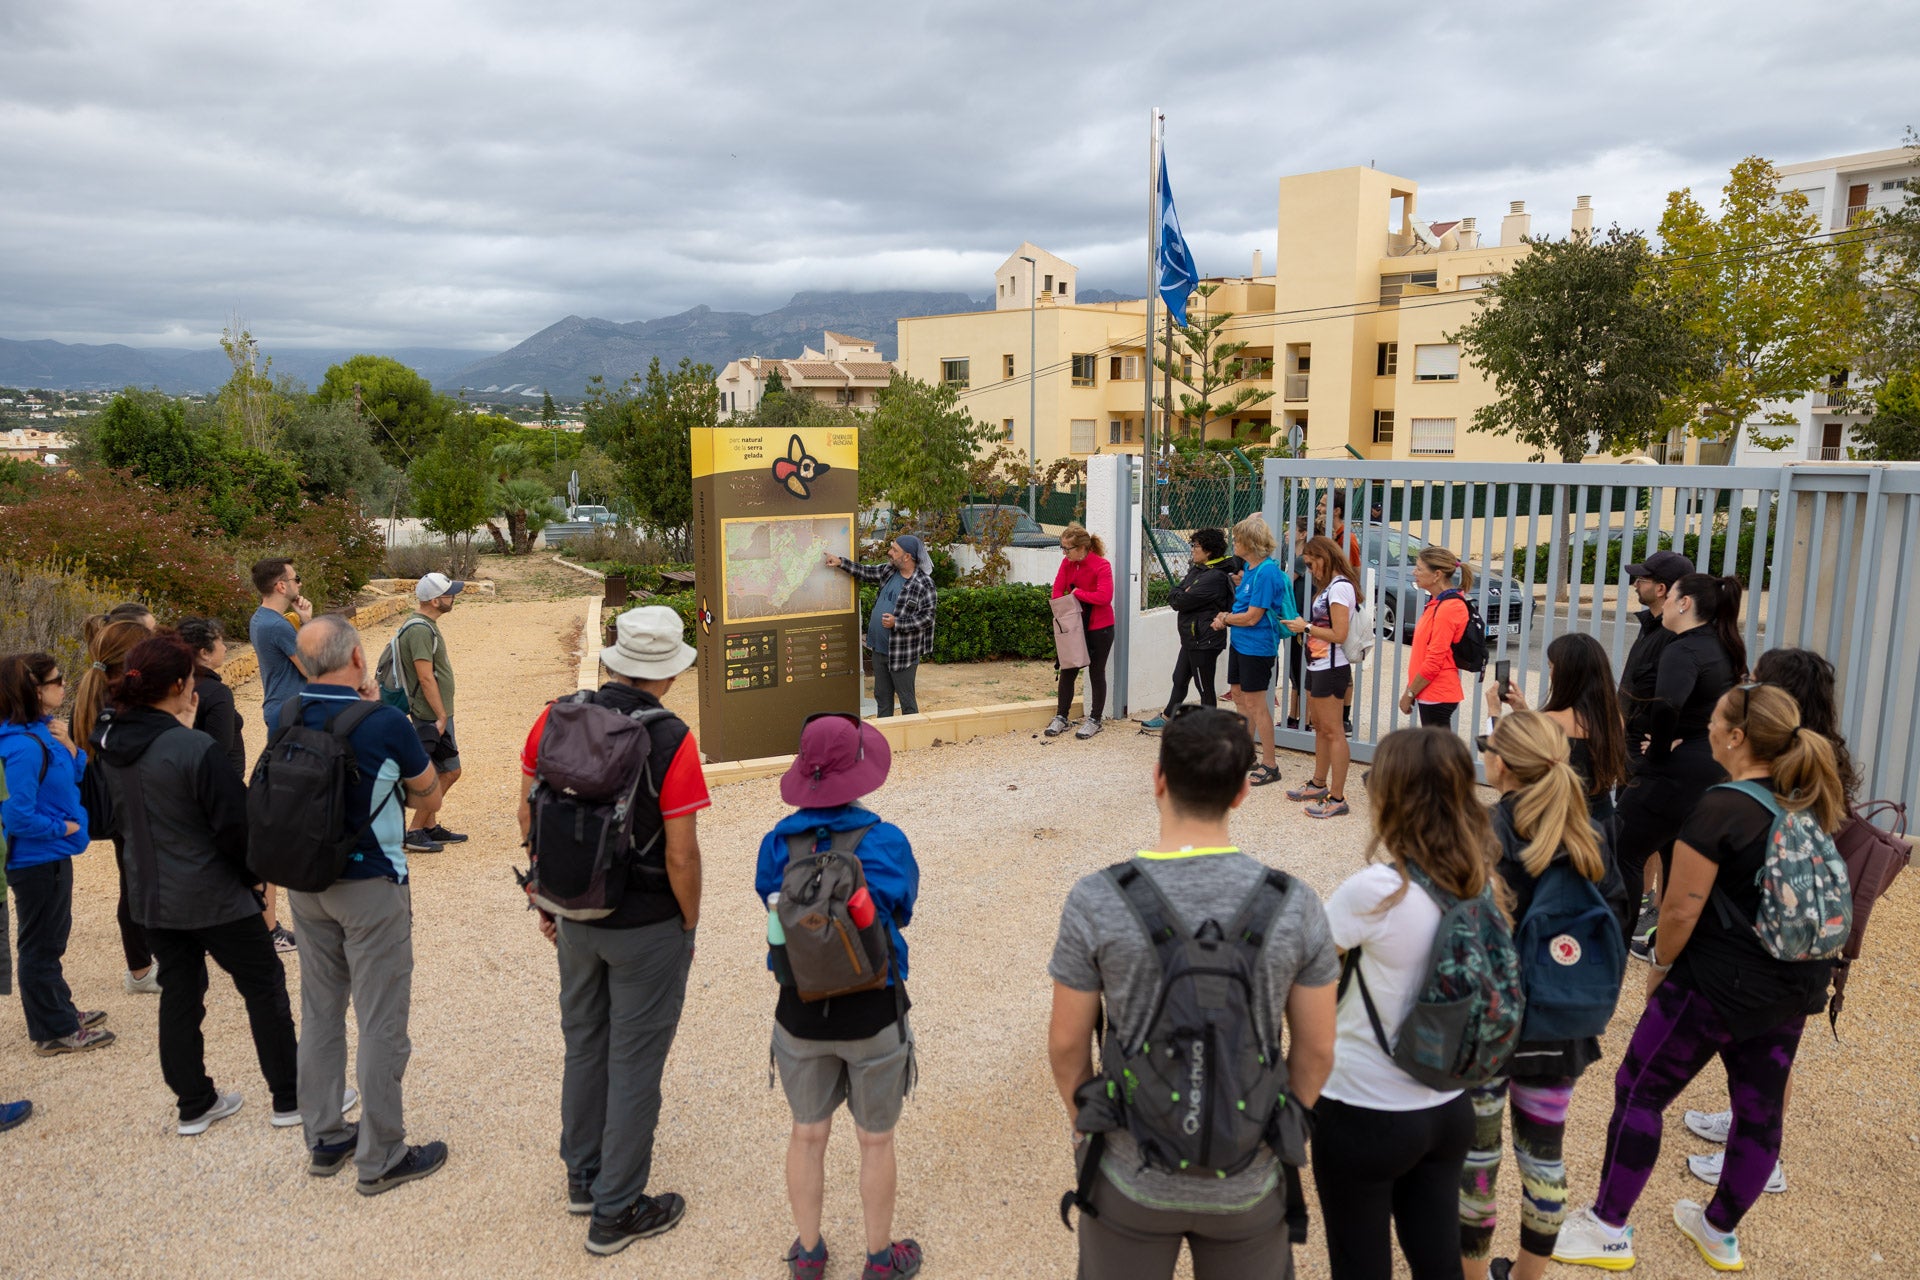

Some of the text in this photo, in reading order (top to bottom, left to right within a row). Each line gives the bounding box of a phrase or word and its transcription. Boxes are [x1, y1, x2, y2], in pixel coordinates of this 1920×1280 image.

[744, 452, 763, 460] gelada
[1183, 1040, 1204, 1135] Quechua
[1603, 1241, 1628, 1252] HOKA
